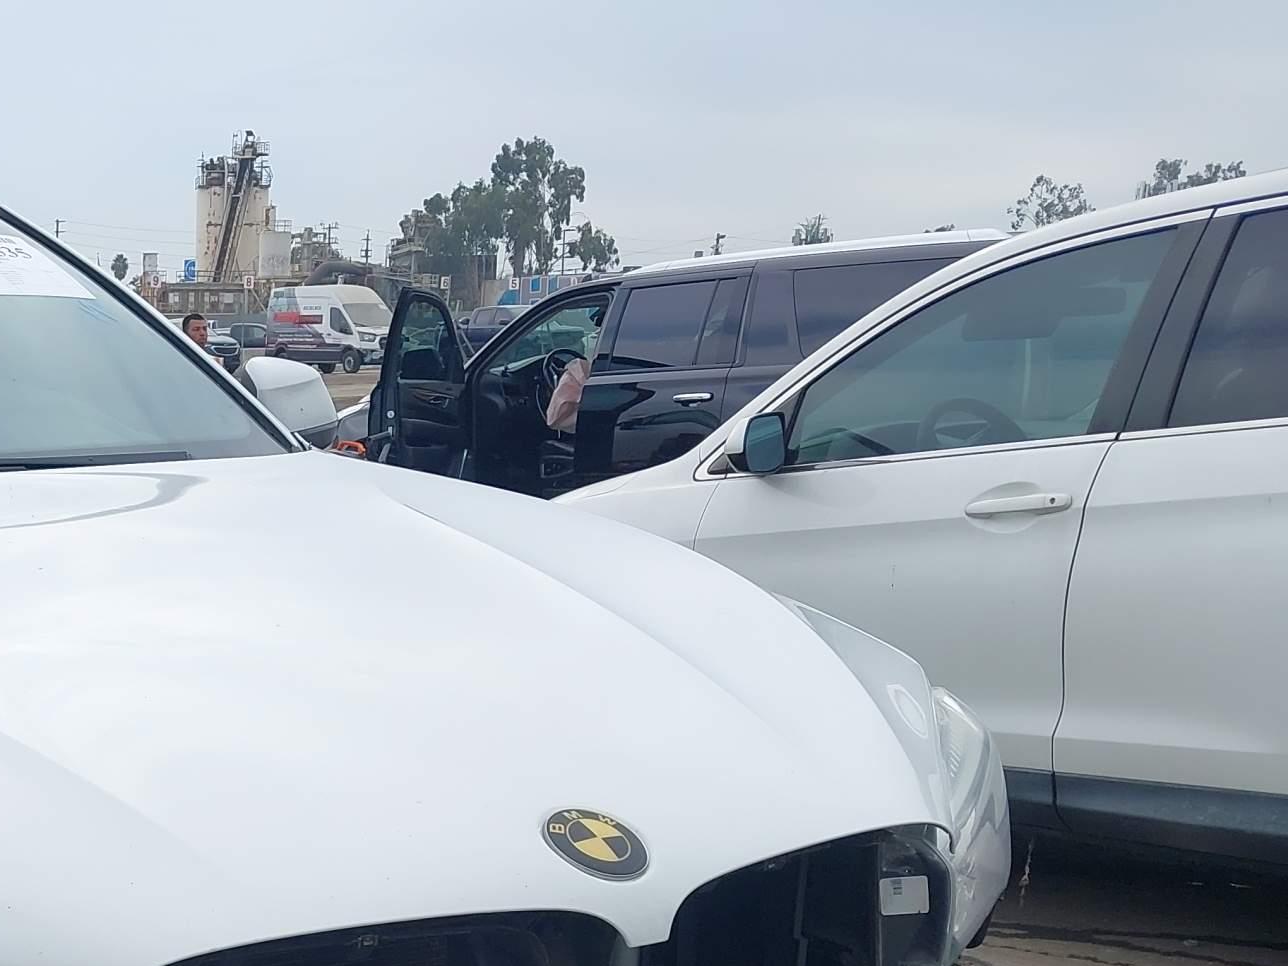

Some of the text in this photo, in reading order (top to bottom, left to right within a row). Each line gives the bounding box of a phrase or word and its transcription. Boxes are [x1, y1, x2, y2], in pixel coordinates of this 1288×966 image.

[152, 275, 160, 286] 9
[245, 277, 252, 288] 8
[442, 278, 449, 288] 6
[511, 278, 518, 289] 5
[549, 810, 617, 834] BMW
